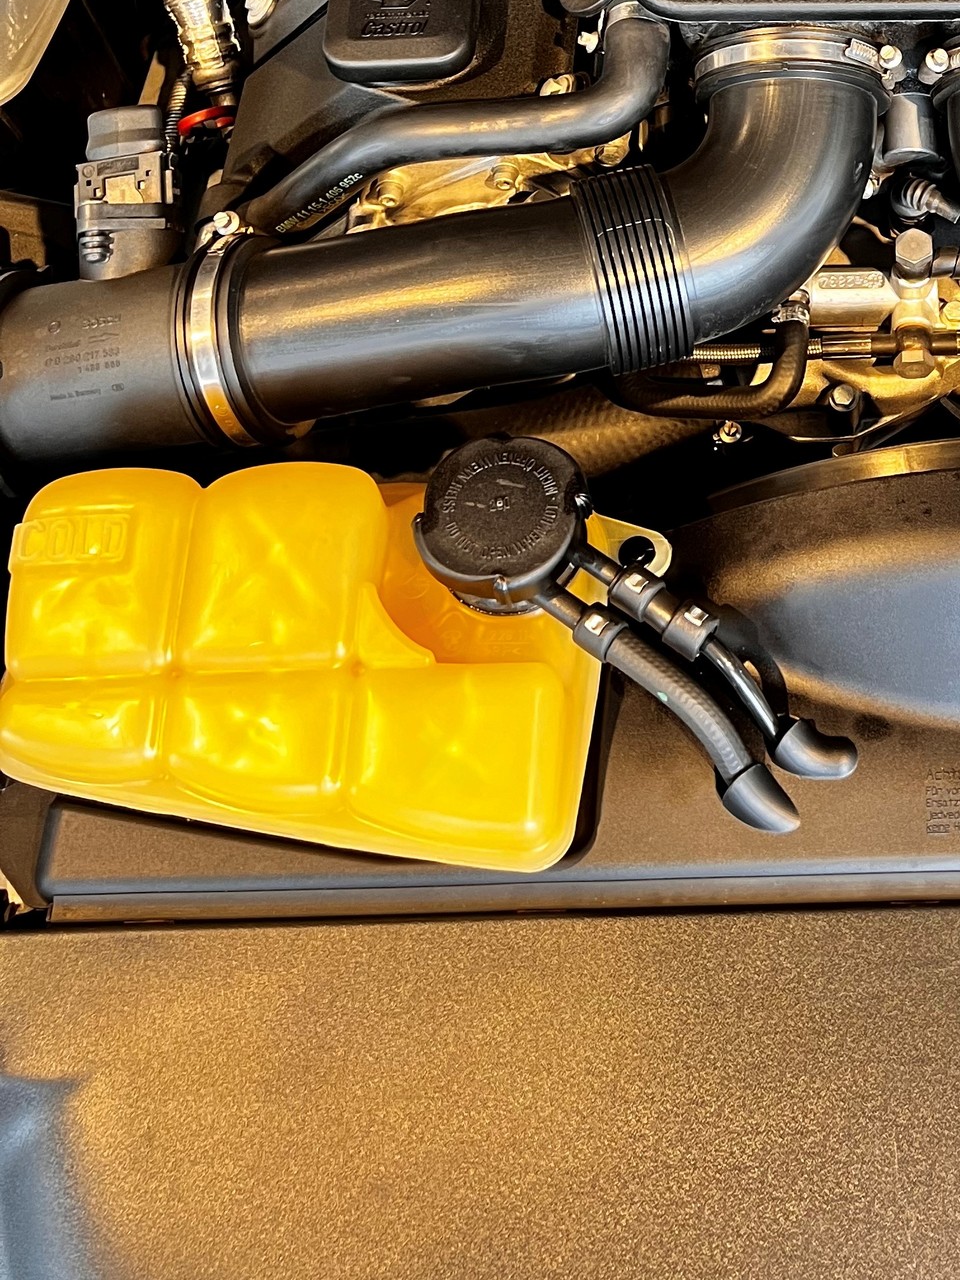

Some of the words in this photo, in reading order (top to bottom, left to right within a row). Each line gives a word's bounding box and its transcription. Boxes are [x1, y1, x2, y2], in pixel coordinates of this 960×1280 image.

[360, 20, 429, 38] Castrol
[275, 215, 301, 234] BMW
[17, 519, 130, 561] COLD
[926, 822, 950, 833] keine
